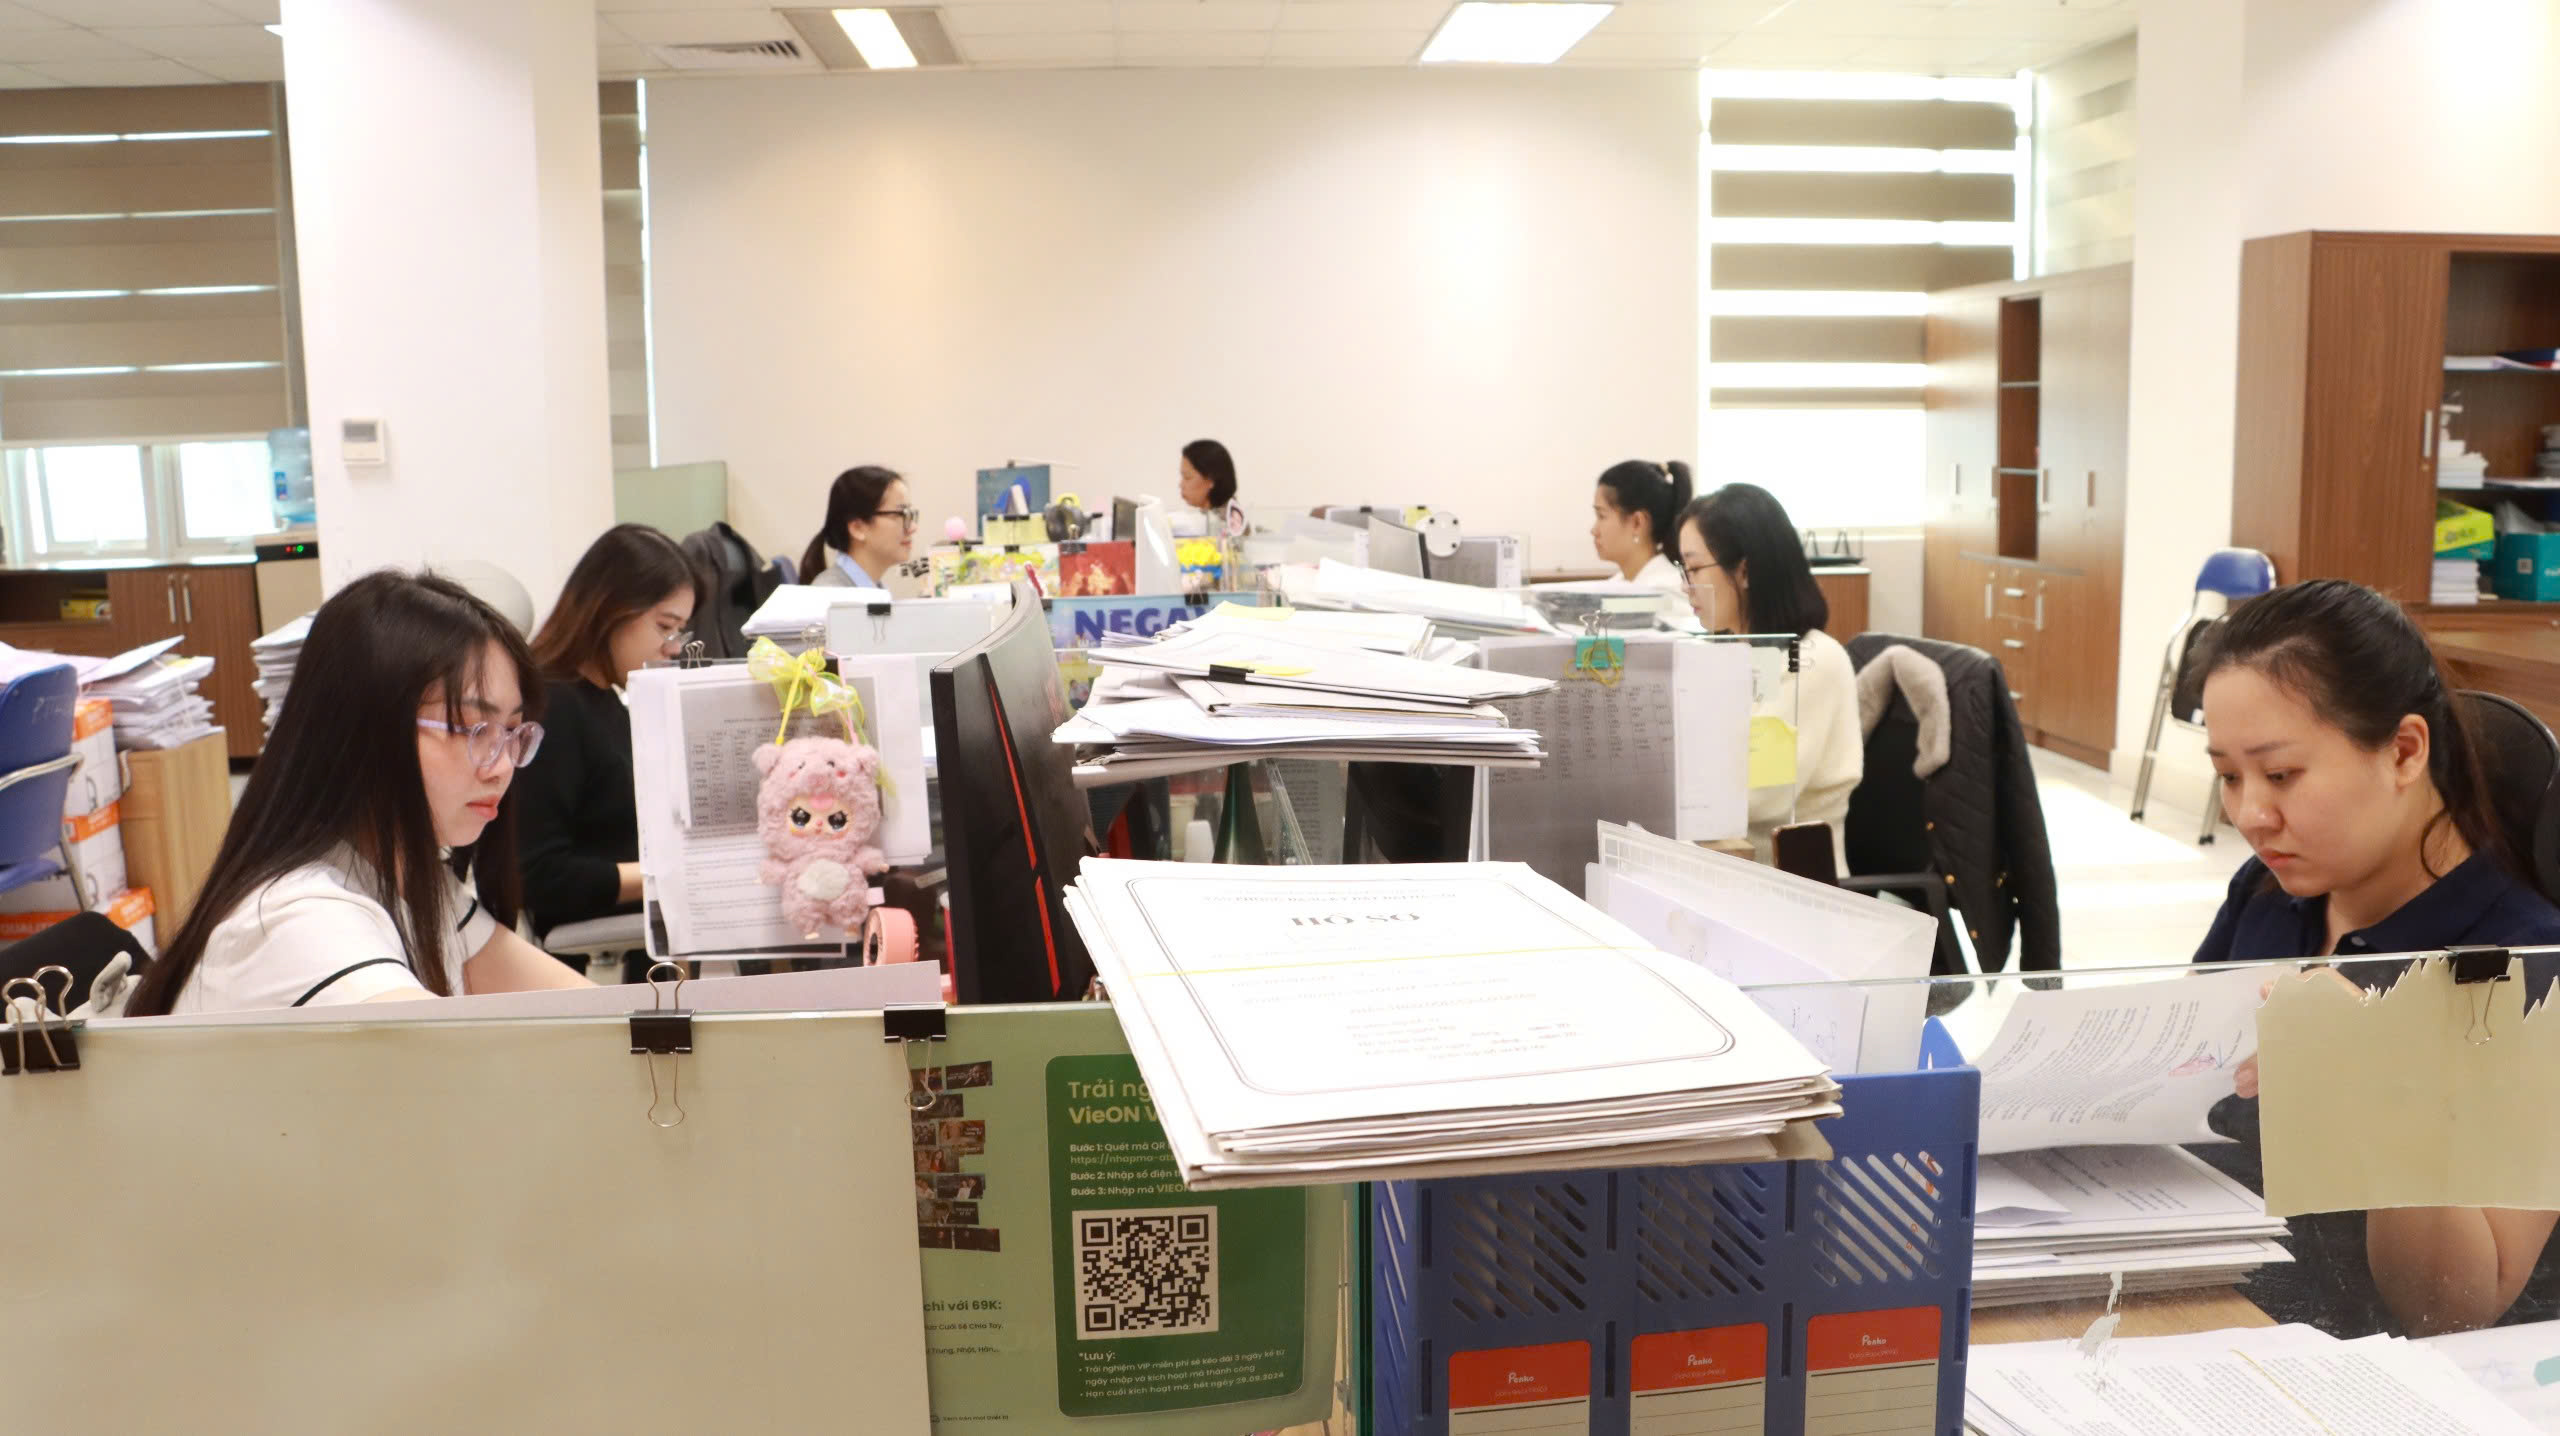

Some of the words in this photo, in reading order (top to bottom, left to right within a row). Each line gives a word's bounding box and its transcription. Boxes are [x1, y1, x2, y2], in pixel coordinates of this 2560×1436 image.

[1067, 1078, 1115, 1099] Trải
[1068, 1105, 1140, 1124] VieON
[1070, 1143, 1095, 1152] Bước
[1096, 1143, 1103, 1152] 1:
[1104, 1142, 1129, 1153] Quét
[1151, 1141, 1166, 1151] QR
[1070, 1171, 1096, 1181] Bước
[1097, 1171, 1105, 1180] 2:
[1106, 1171, 1135, 1183] Nhập
[1136, 1169, 1148, 1179] số
[1150, 1169, 1172, 1180] điện
[1071, 1187, 1096, 1197] Bước
[1097, 1187, 1106, 1196] 3:
[1108, 1186, 1136, 1196] Nhập
[947, 1300, 969, 1311] với
[972, 1300, 1002, 1311] 69K:
[968, 1322, 988, 1330] Chia
[1085, 1377, 1108, 1387] ngày
[1085, 1390, 1105, 1399] Hạn
